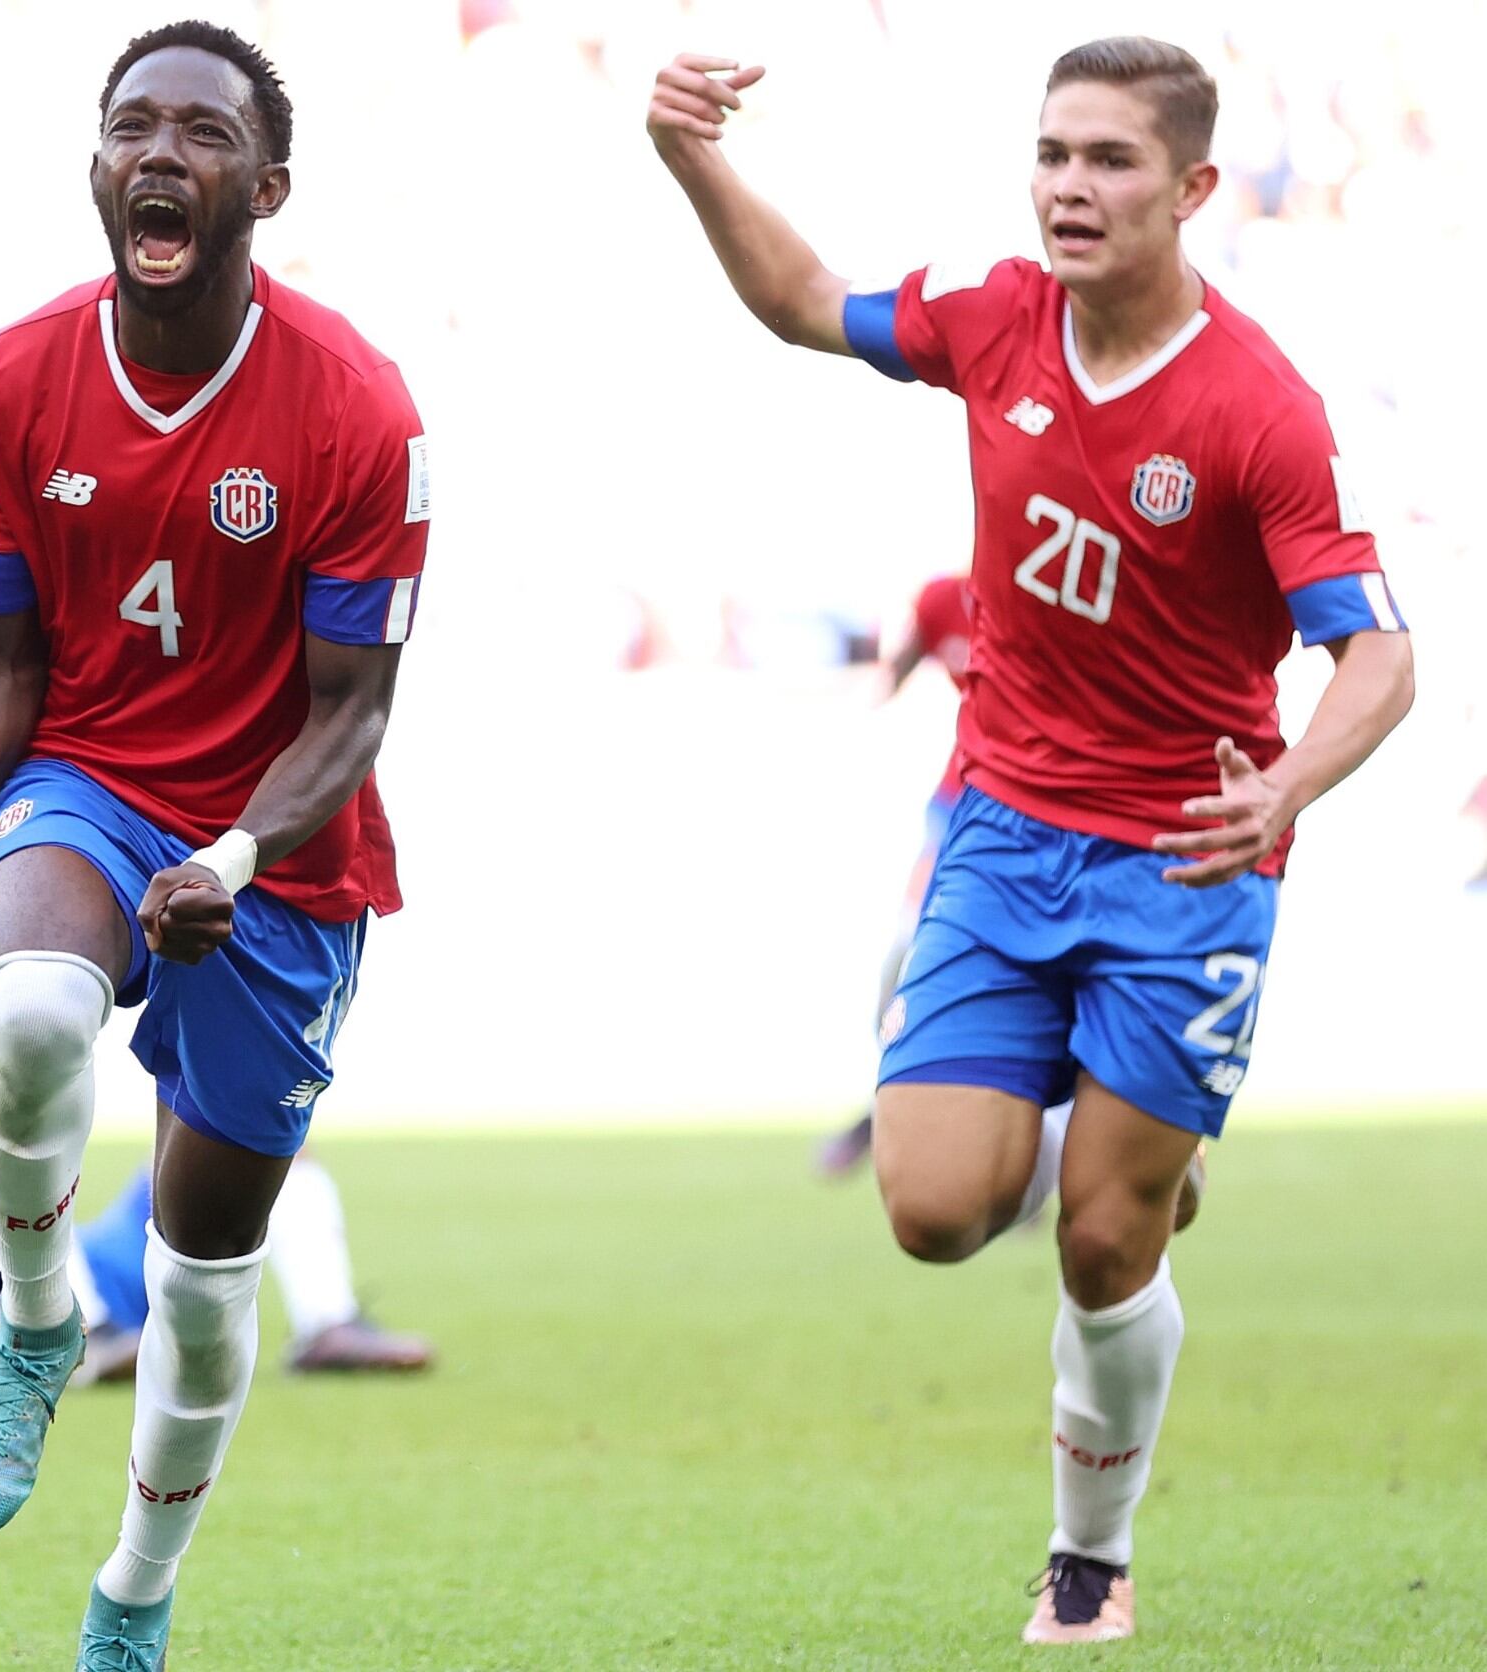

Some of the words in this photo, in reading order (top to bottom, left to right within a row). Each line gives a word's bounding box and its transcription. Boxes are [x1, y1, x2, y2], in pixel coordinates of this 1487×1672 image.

[226, 483, 262, 530] CR
[1146, 471, 1182, 511] CR
[1014, 493, 1122, 625] 20
[118, 559, 185, 657] 4
[131, 1455, 212, 1505] CRF
